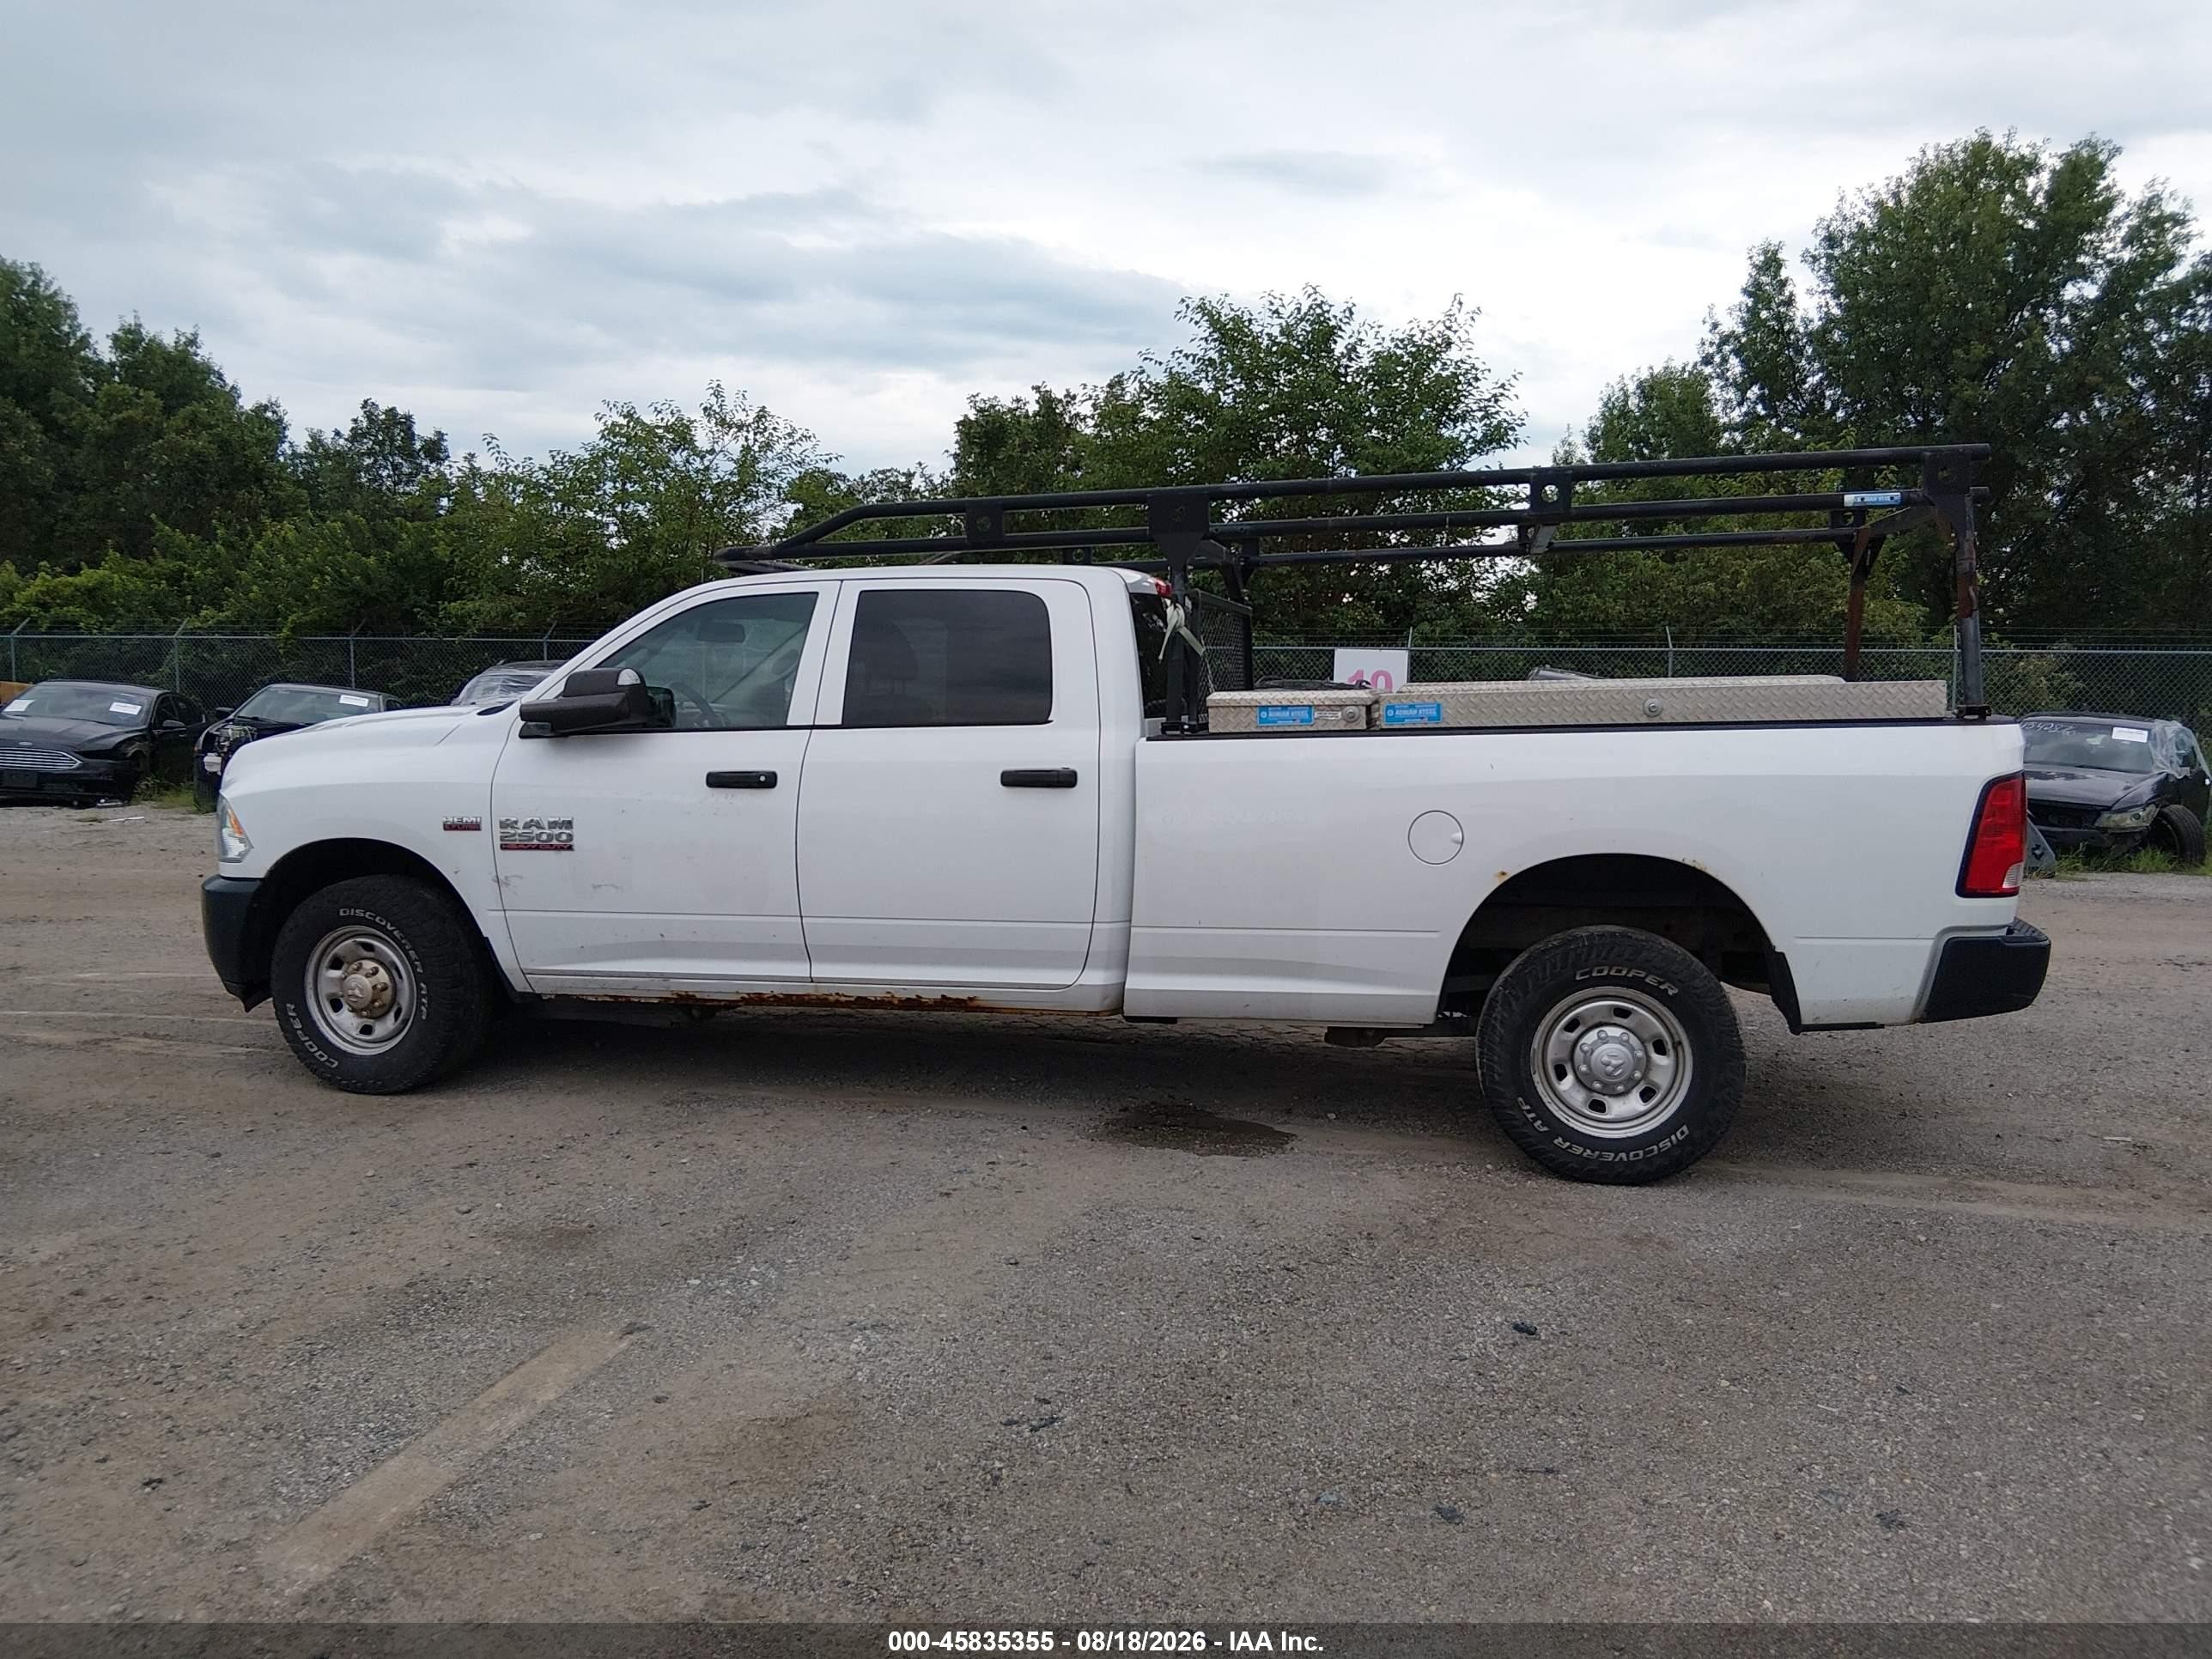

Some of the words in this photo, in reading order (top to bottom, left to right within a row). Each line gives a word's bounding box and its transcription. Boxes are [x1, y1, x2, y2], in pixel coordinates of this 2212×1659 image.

[499, 817, 574, 830] RAM
[499, 830, 574, 842] 2500
[339, 908, 423, 974] DISCOVERER
[1576, 965, 1680, 996] COOPER
[285, 1002, 339, 1069] COOPER
[1553, 1124, 1690, 1163] DISCOVERER
